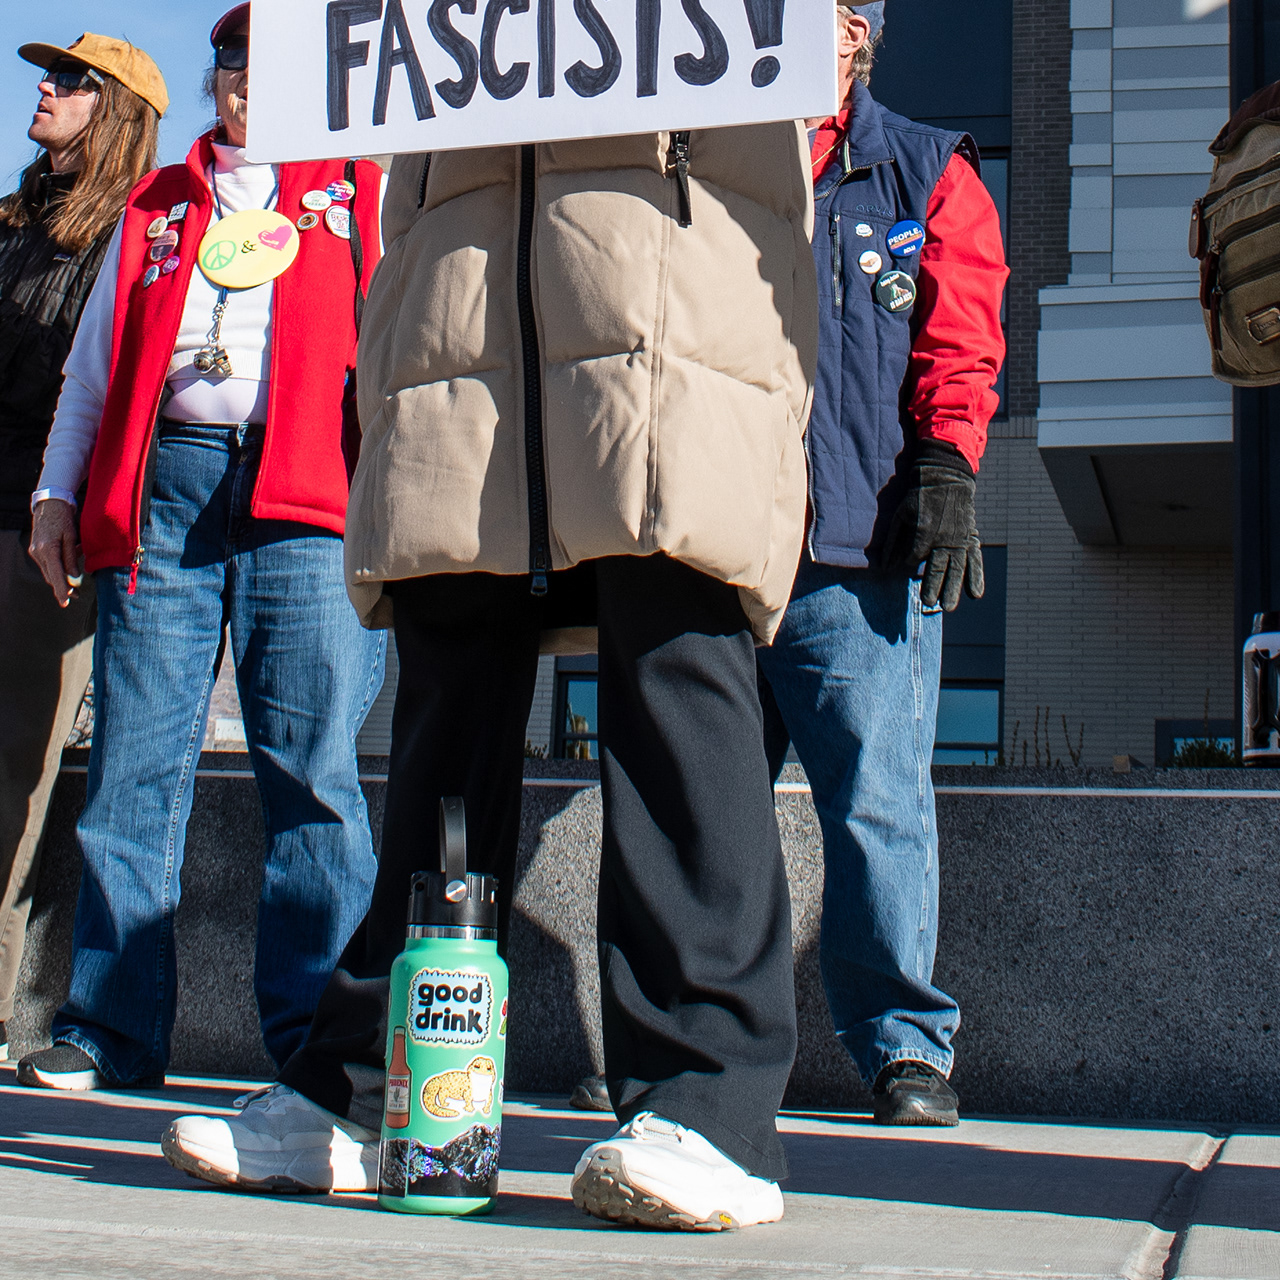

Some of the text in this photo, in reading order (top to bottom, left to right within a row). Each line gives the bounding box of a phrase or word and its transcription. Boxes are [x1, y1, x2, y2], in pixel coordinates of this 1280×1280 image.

[856, 204, 894, 218] ORVIS
[417, 982, 483, 1006] good
[415, 1007, 484, 1034] drink
